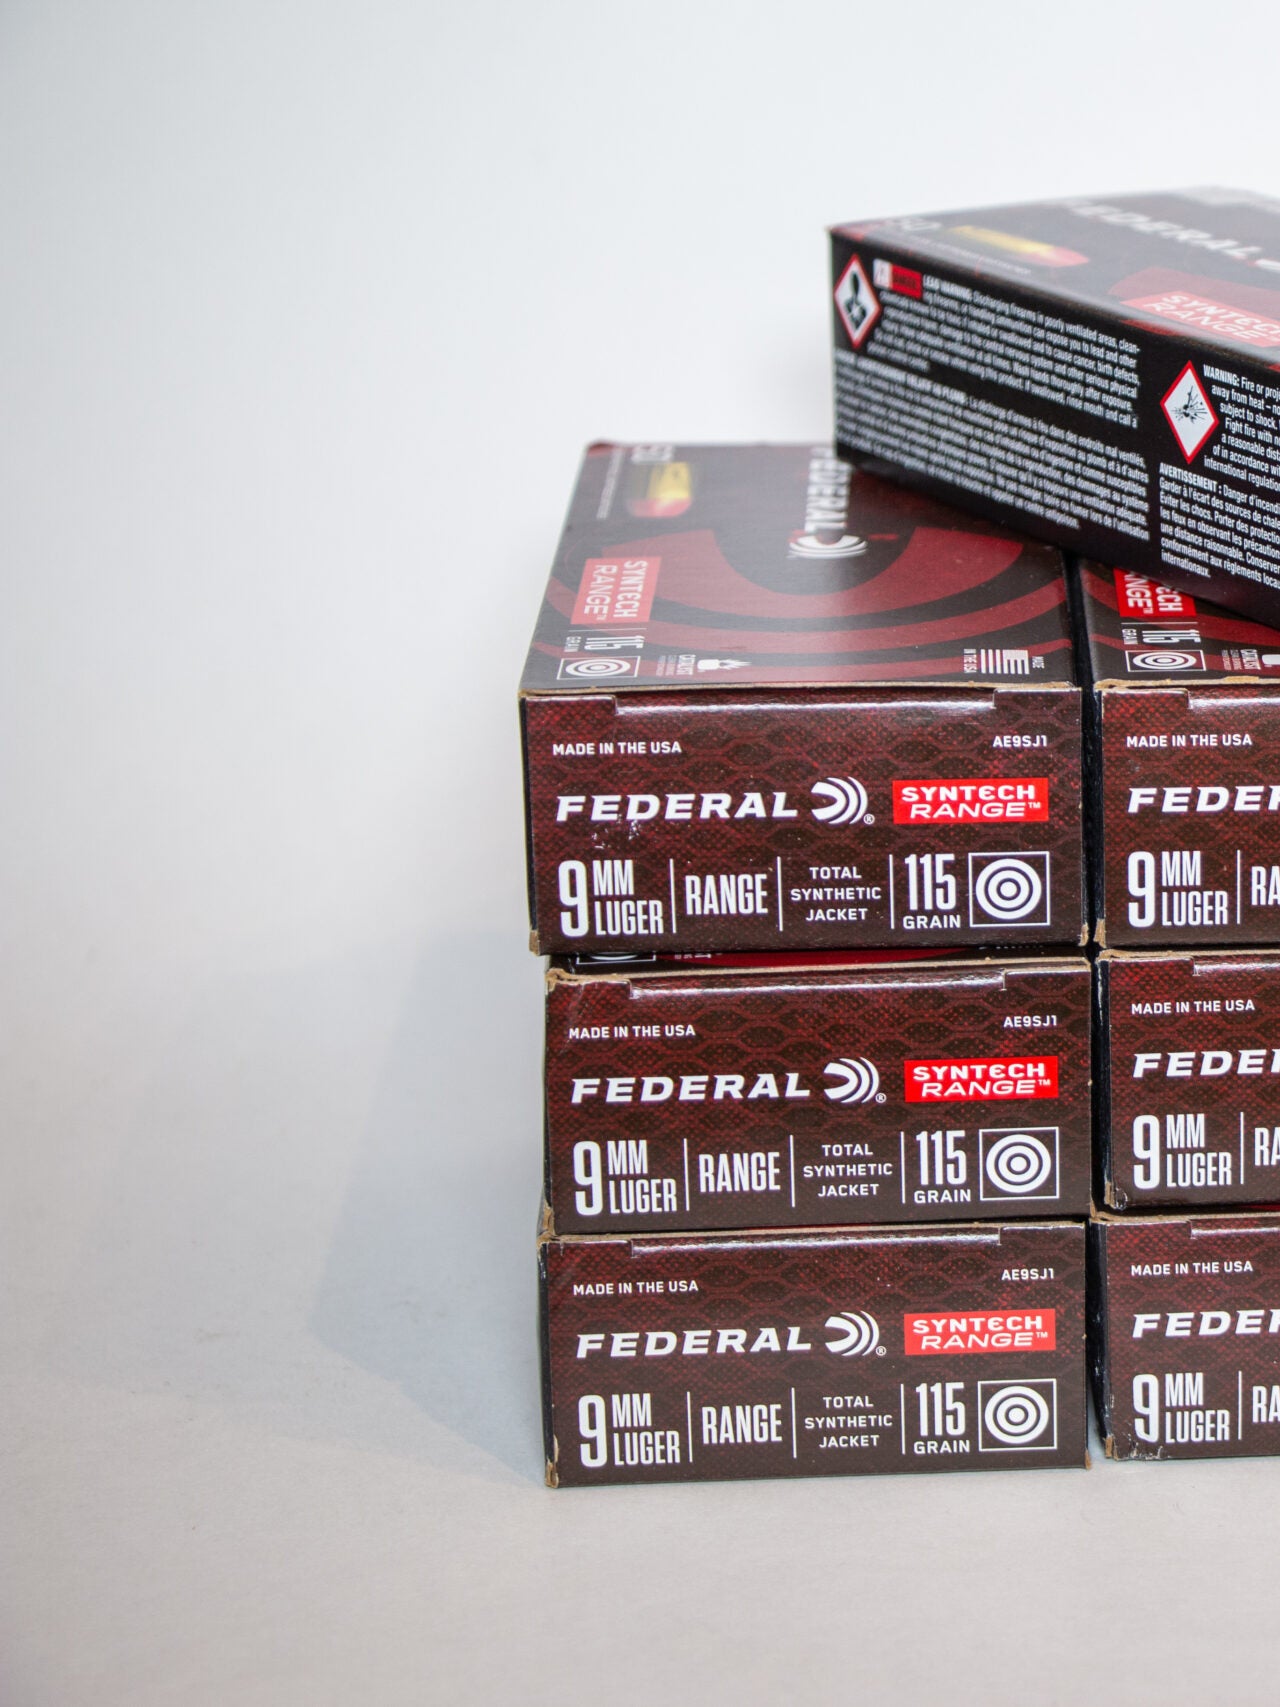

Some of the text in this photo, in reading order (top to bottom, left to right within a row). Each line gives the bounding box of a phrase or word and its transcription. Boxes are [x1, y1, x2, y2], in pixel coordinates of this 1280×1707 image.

[1241, 376, 1254, 391] Fire
[1211, 384, 1230, 400] away
[1231, 388, 1247, 404] from
[1248, 394, 1264, 410] heat
[1219, 402, 1245, 419] subject
[1224, 416, 1243, 433] Fight
[1243, 423, 1255, 437] fire
[1257, 429, 1272, 443] with
[1227, 435, 1264, 456] reasonable
[1203, 455, 1246, 480] international
[1229, 450, 1269, 472] accordance
[1159, 462, 1217, 492] AVERTISSEMENT
[1223, 484, 1247, 502] Danger
[613, 560, 648, 618] SYNTECH
[584, 635, 645, 650] 115
[1141, 629, 1201, 643] 115
[992, 734, 1048, 749] AE9SJ1
[1126, 733, 1253, 748] MADE IN THE USA
[901, 784, 1037, 803] SYNTECH
[555, 791, 799, 823] FEDERAL
[903, 852, 958, 911] 115
[684, 873, 769, 916] RANGE
[593, 899, 665, 937] LUGER
[902, 914, 962, 931] GRAIN
[912, 1062, 1046, 1082] SYNTECH
[570, 1071, 812, 1105] FEDERAL
[915, 1129, 968, 1186] 115
[1166, 1151, 1233, 1189] LUGER
[697, 1151, 782, 1193] RANGE
[608, 1178, 678, 1215] LUGER
[913, 1188, 972, 1205] GRAIN
[572, 1279, 699, 1296] MADE IN THE USA
[912, 1314, 1044, 1335] SYNTECH
[575, 1325, 813, 1359] FEDERAL
[914, 1381, 967, 1437] 115
[700, 1403, 783, 1445] RANGE
[912, 1439, 971, 1456] GRAIN
